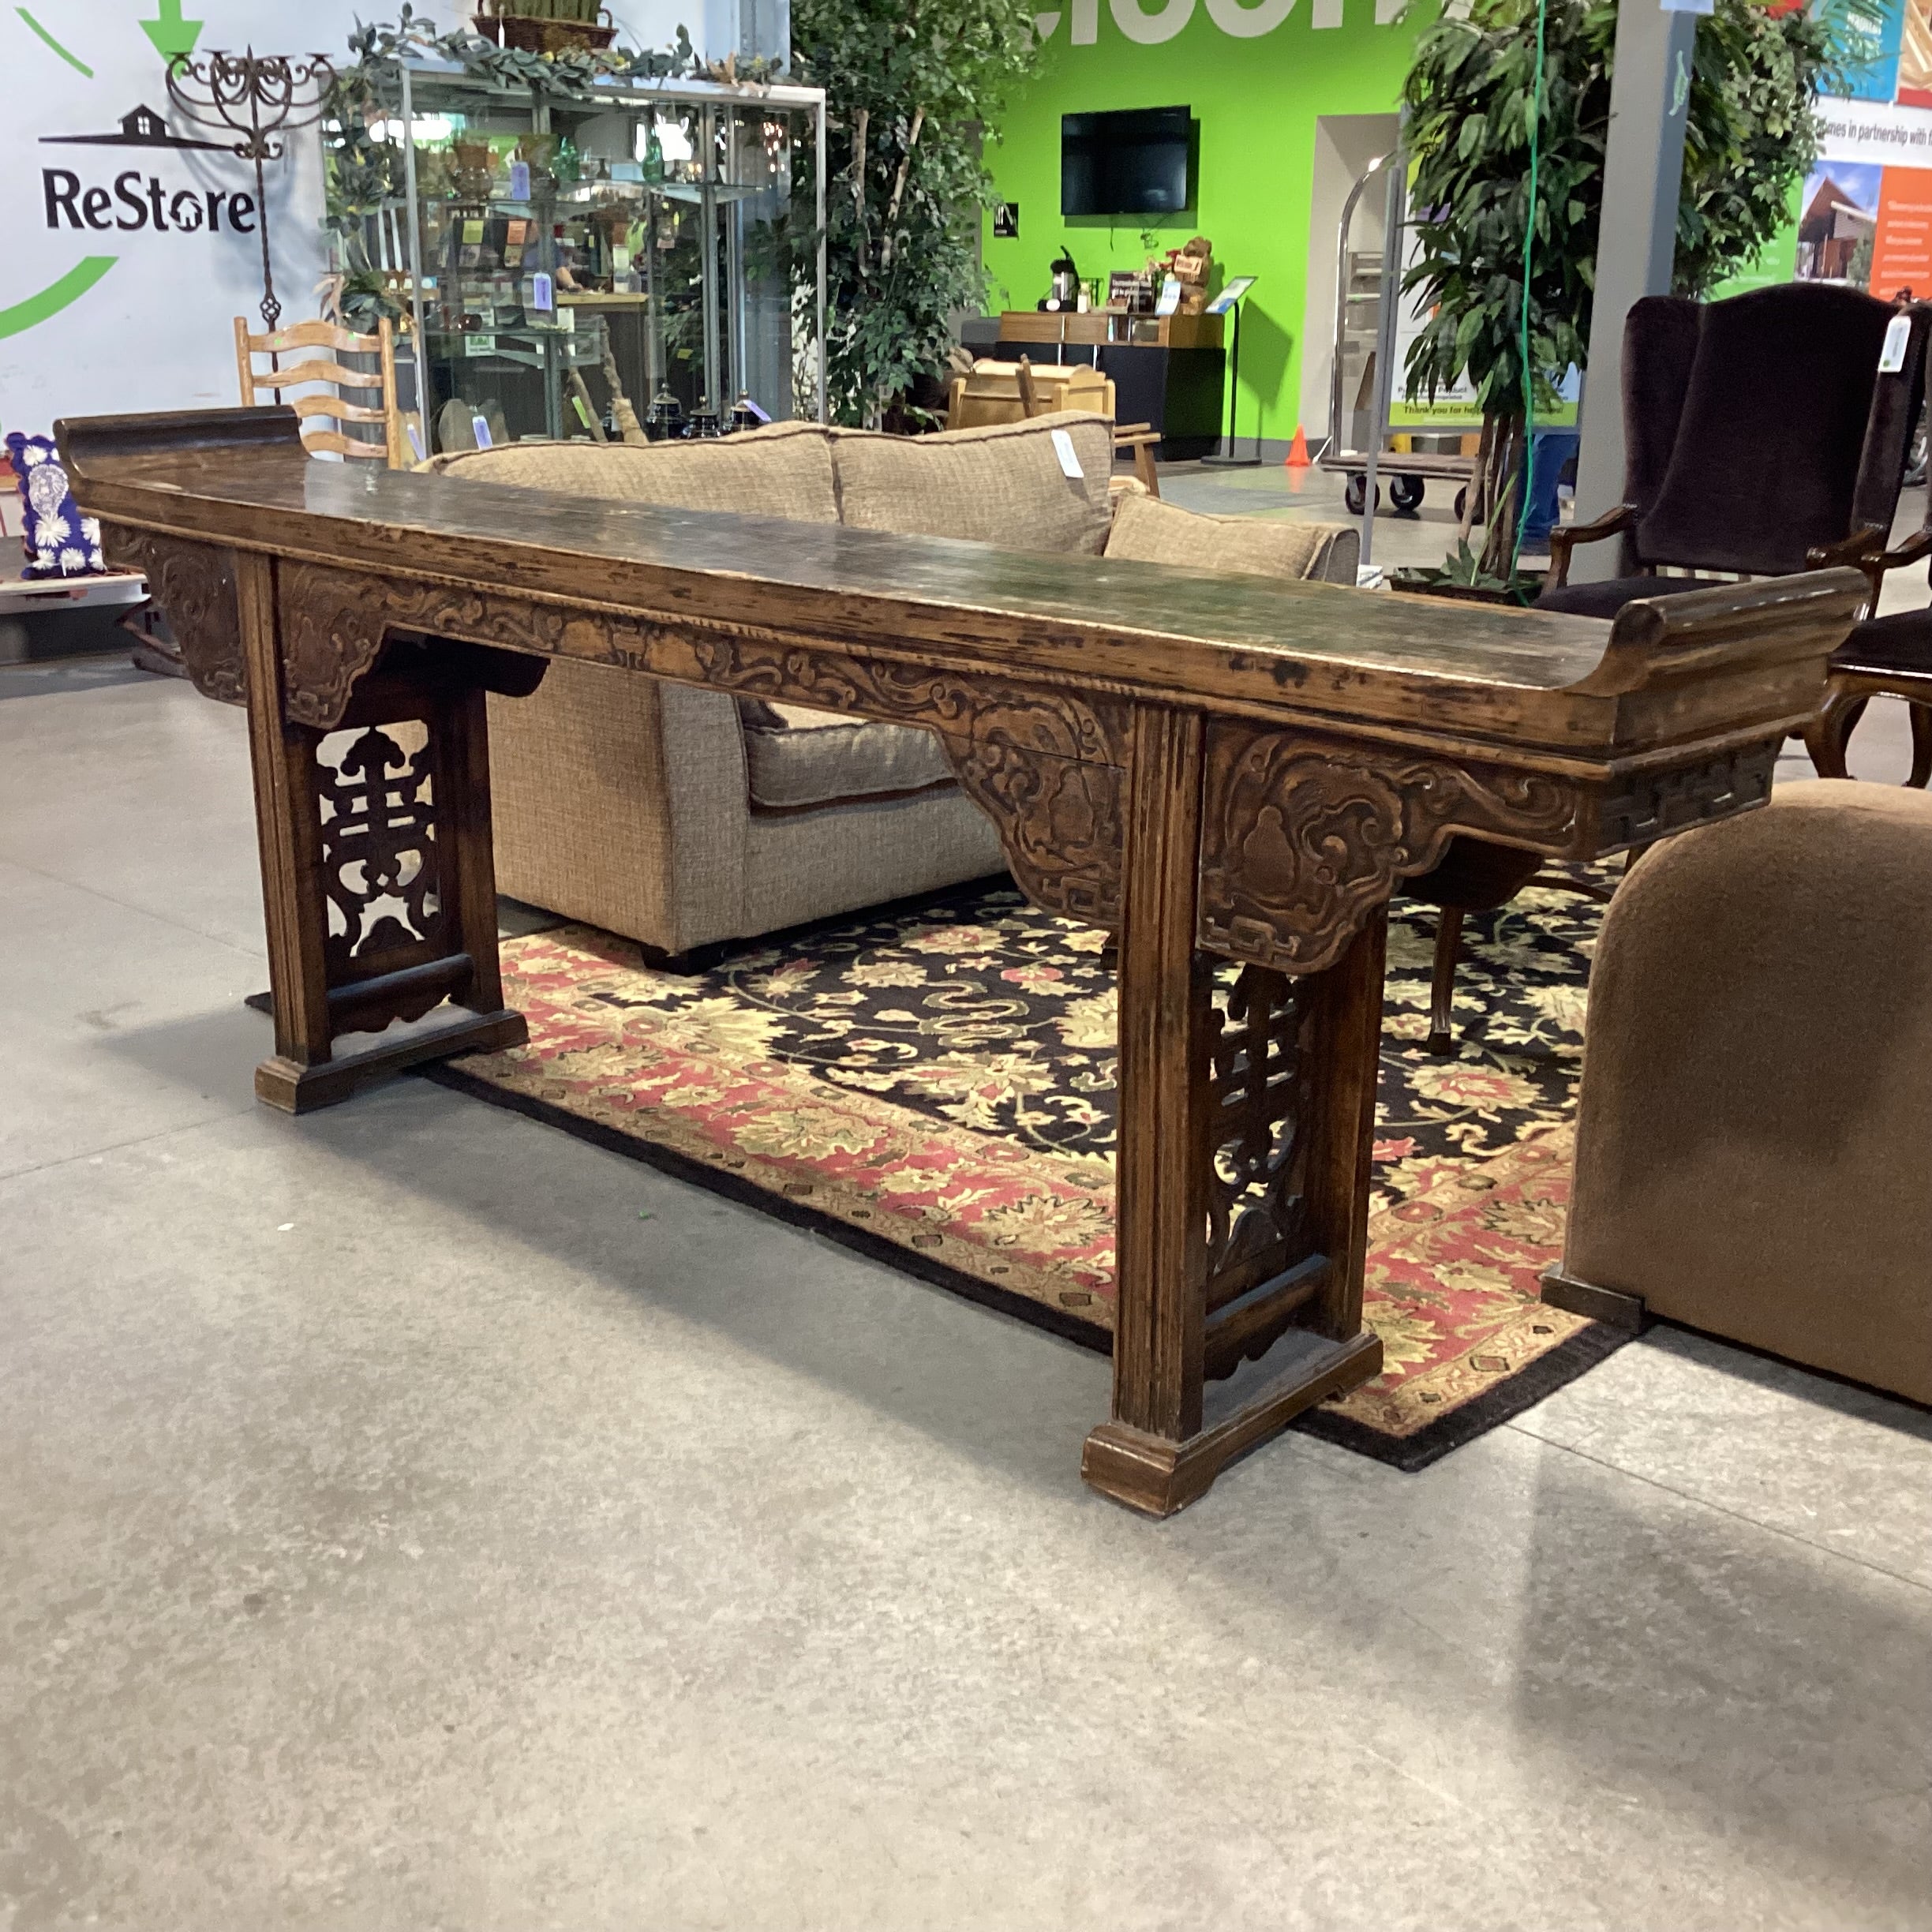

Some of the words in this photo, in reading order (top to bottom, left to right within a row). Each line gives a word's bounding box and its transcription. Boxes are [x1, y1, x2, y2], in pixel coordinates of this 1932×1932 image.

[1848, 120, 1857, 138] in
[1858, 124, 1908, 147] partnership
[1909, 127, 1926, 145] with
[42, 168, 256, 233] ReStore
